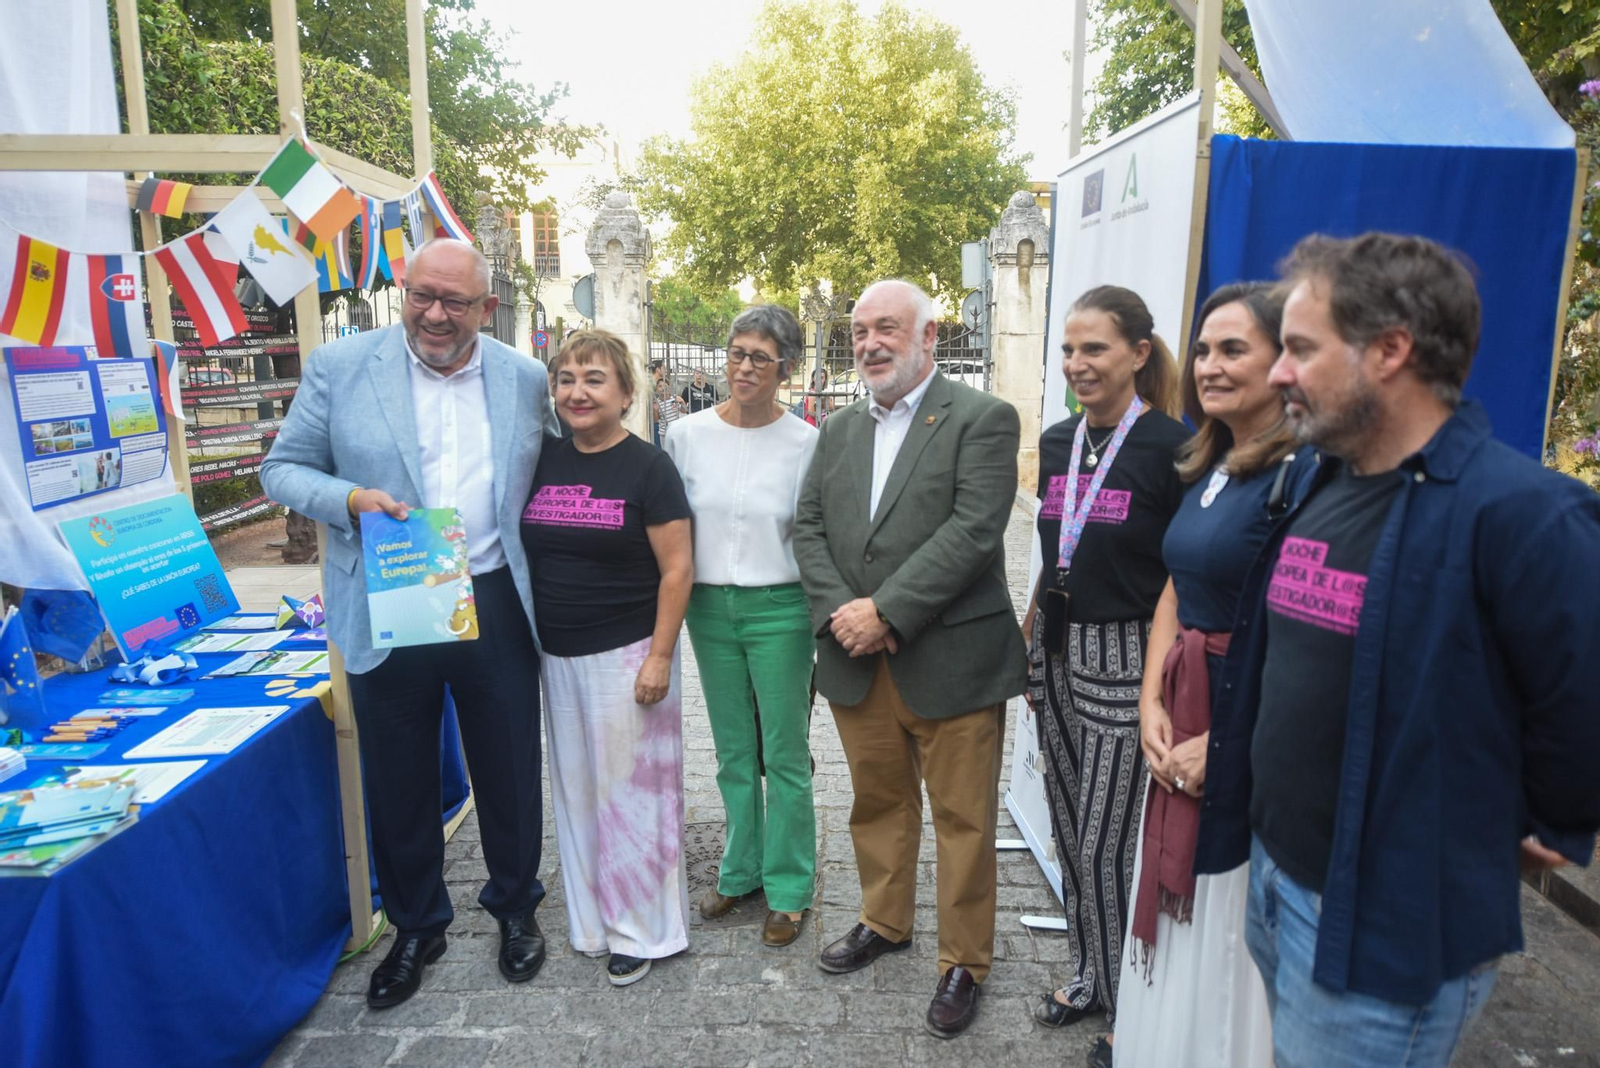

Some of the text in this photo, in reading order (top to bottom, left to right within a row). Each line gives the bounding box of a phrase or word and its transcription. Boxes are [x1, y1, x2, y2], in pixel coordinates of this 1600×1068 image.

[253, 421, 273, 429] CARMEN
[239, 433, 263, 442] CABALLERO
[191, 465, 203, 473] ORES
[204, 463, 218, 471] REDEL
[201, 473, 214, 482] POLO
[234, 466, 253, 476] MELANIA
[540, 487, 588, 497] LA NOCHE
[532, 498, 621, 510] EUROPEA DE L@S
[90, 555, 119, 568] Participa
[118, 552, 127, 560] en
[127, 545, 149, 557] nuestro
[149, 538, 174, 550] concurso
[375, 540, 413, 555] ¡Vamos
[1286, 542, 1323, 562] NOCHE
[115, 566, 124, 575] un
[124, 557, 149, 573] obsequio
[154, 552, 167, 561] eres
[186, 539, 208, 552] primeros
[378, 551, 428, 566] a explorar
[141, 559, 169, 574] en acertar
[381, 563, 427, 579] Europa!
[135, 581, 151, 593] SABES
[150, 578, 158, 587] DE
[1312, 571, 1330, 588] DE
[1331, 575, 1367, 597] L@S
